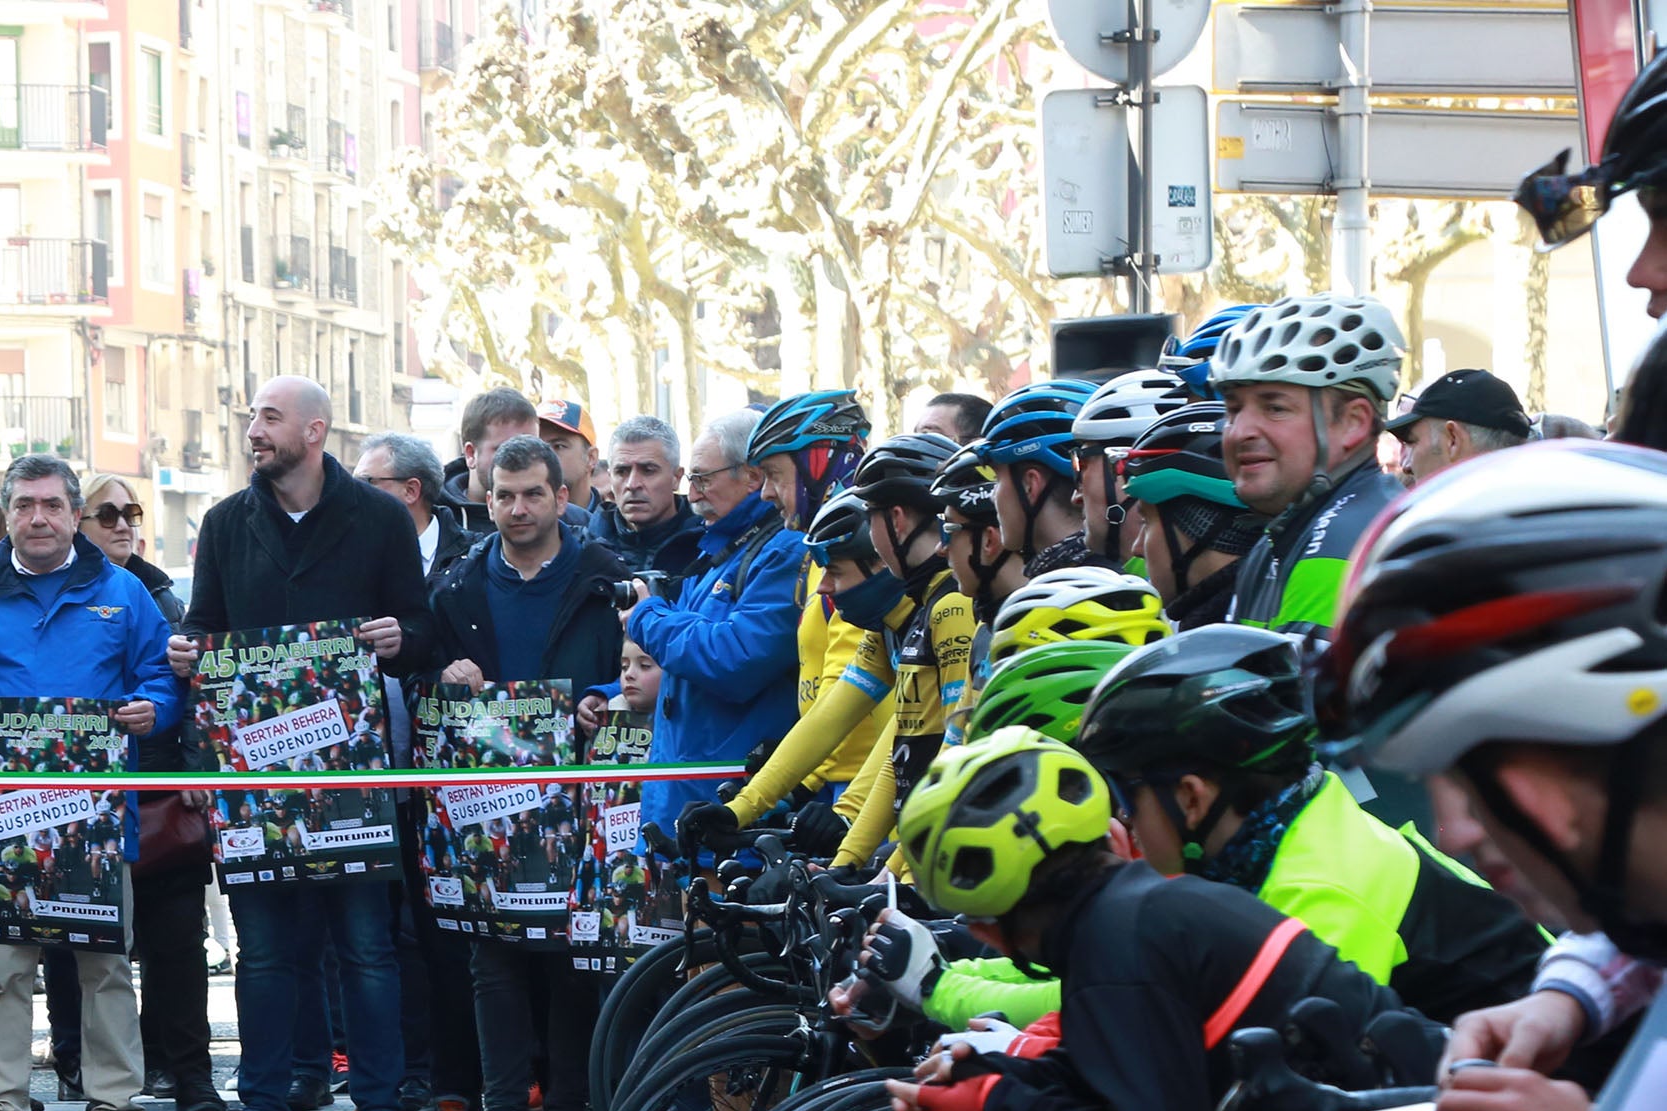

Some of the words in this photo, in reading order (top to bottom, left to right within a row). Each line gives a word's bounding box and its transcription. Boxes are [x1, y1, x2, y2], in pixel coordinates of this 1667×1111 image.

[199, 649, 235, 678] 45
[239, 636, 355, 664] UDABERRI
[337, 655, 371, 672] 2023
[216, 690, 230, 709] 5
[417, 697, 440, 726] 45
[442, 698, 552, 718] UDABERRI
[243, 721, 289, 745] BERTAN
[291, 707, 337, 730] BEHERA
[534, 718, 568, 733] 2023
[88, 735, 121, 750] 2023
[249, 723, 342, 761] SUSPENDIDO
[426, 737, 436, 757] 5
[593, 726, 617, 755] 45
[451, 789, 535, 820] SUSPENDIDO
[324, 829, 391, 843] PNEUMAX
[610, 827, 636, 844] SUS
[52, 905, 117, 917] PNEUMAX
